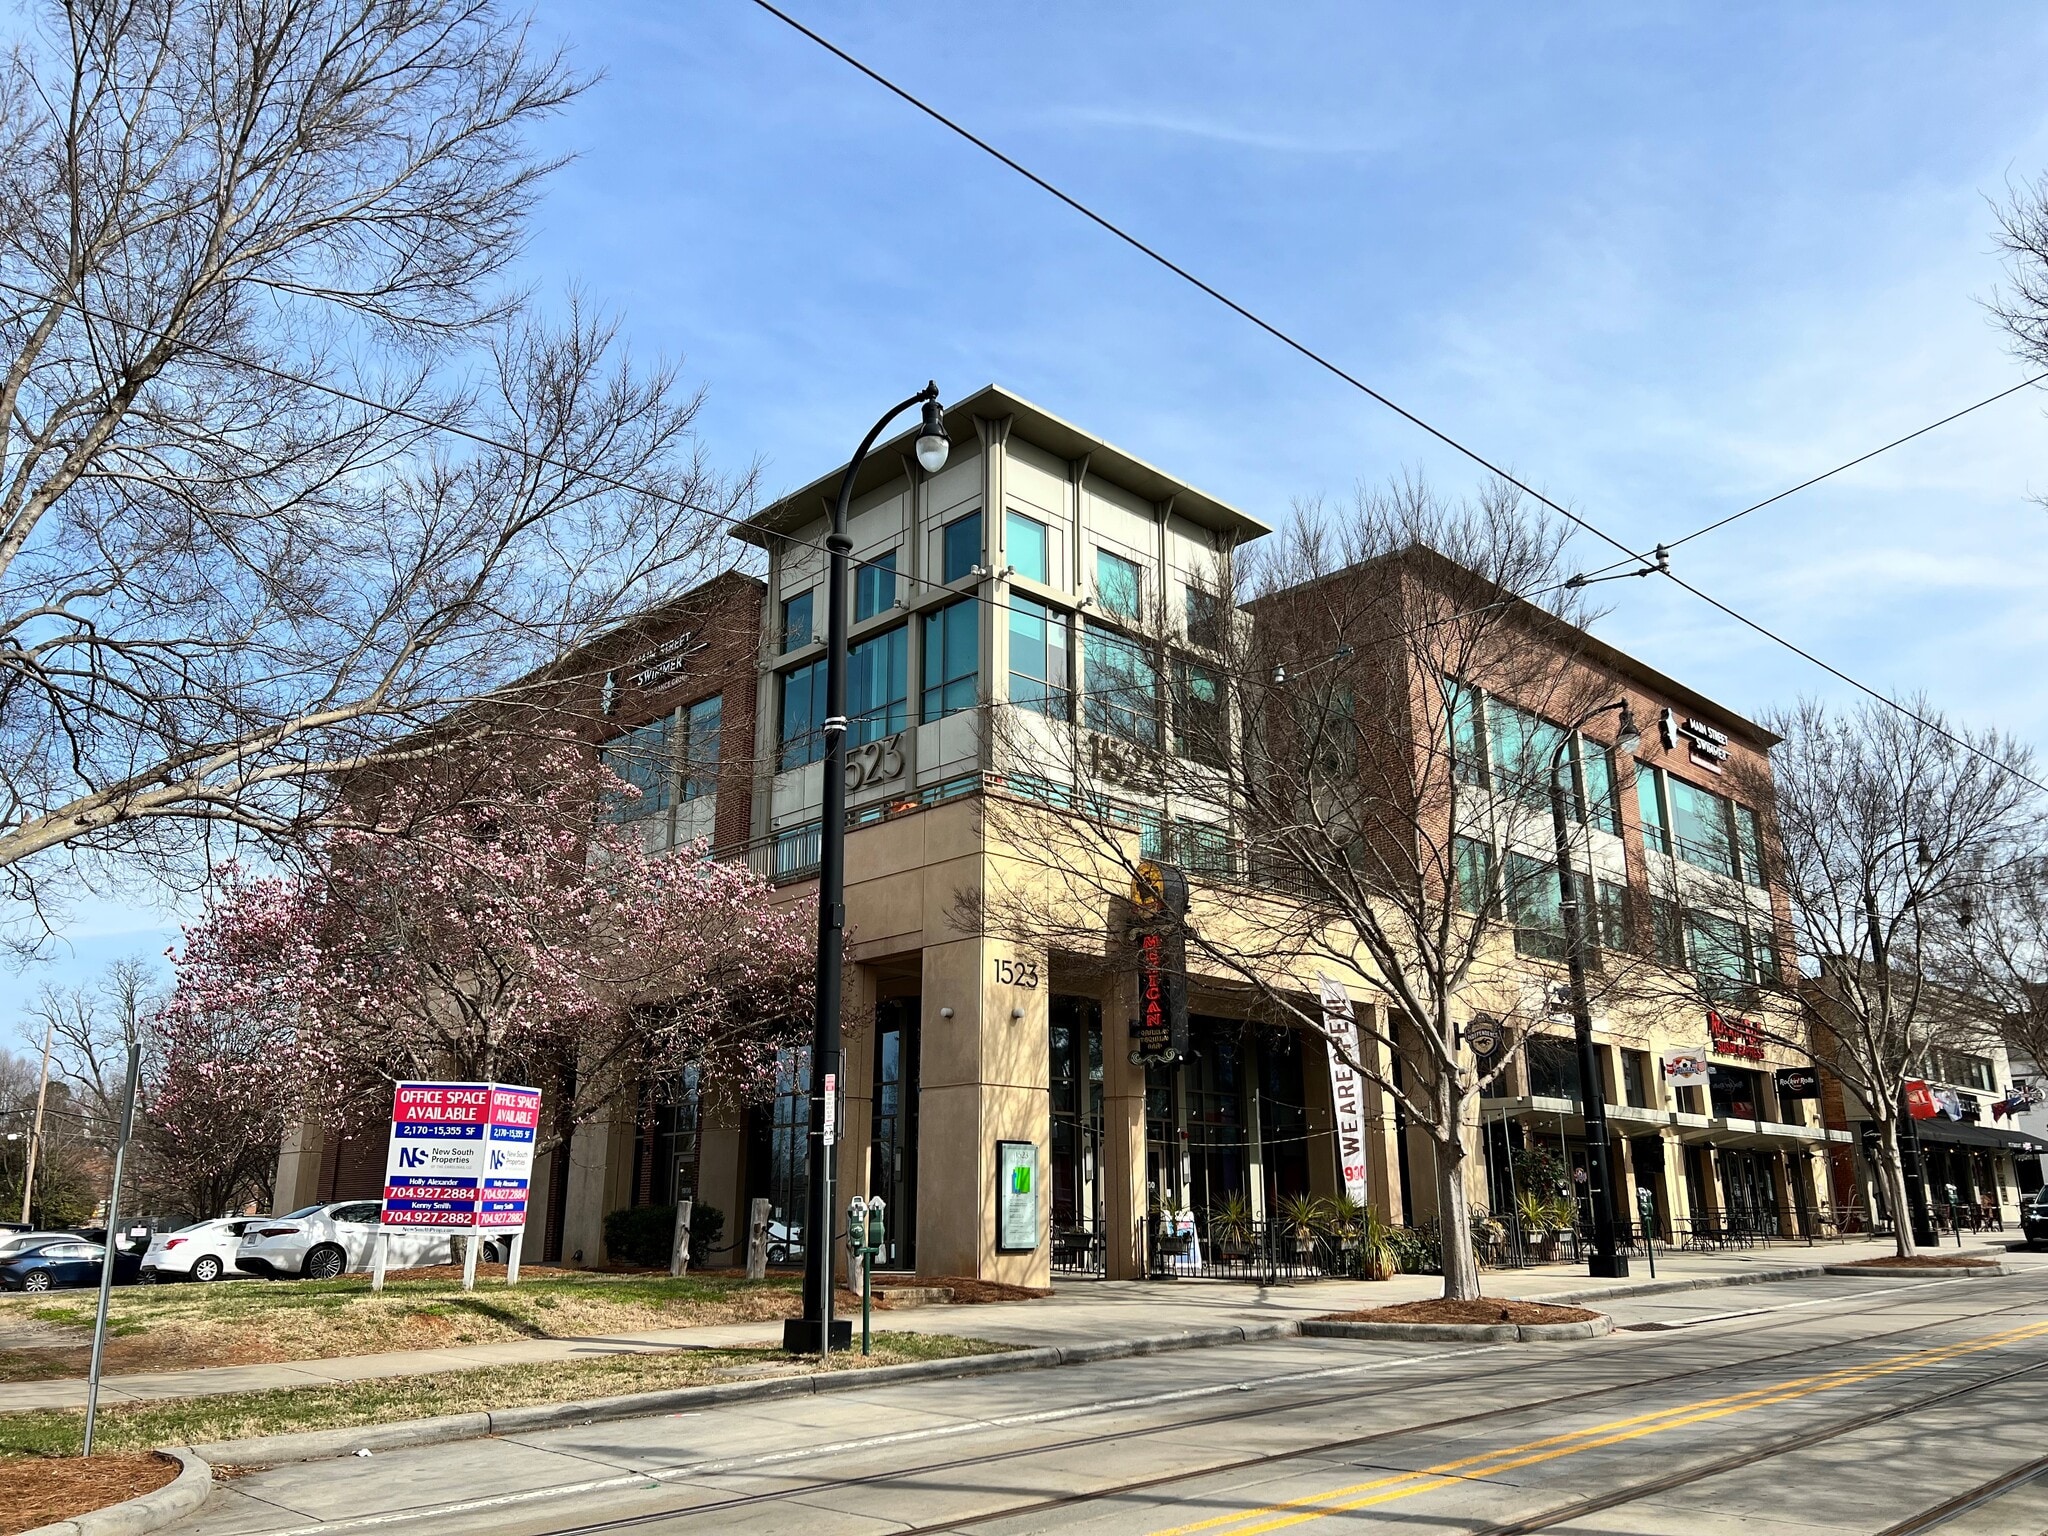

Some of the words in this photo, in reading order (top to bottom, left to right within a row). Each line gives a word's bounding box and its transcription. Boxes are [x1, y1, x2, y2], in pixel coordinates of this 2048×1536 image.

[845, 733, 904, 791] 523
[994, 958, 1039, 989] 1523
[1142, 935, 1162, 1027] MEICAN
[400, 1090, 443, 1104] OFFICE
[446, 1092, 487, 1105] SPACE
[1335, 1069, 1357, 1115] ARE
[493, 1092, 517, 1108] OFFICE
[517, 1096, 538, 1110] SPACE
[406, 1107, 478, 1121] AVAILABLE
[496, 1108, 533, 1125] AVAILABLE
[403, 1126, 462, 1136] 2,170-15,355
[465, 1127, 476, 1136] SF
[1340, 1119, 1361, 1158] WE
[399, 1147, 430, 1168] NS
[432, 1147, 451, 1155] New
[451, 1148, 474, 1156] South
[431, 1156, 470, 1165] Properties
[409, 1178, 425, 1186] Holly
[427, 1178, 459, 1186] Alexander
[389, 1187, 475, 1200] 704.927.2884
[483, 1189, 527, 1201] 704.927.2884
[412, 1202, 431, 1210] Kenny
[433, 1202, 451, 1210] Smith
[387, 1211, 473, 1224] 704.927.2882
[480, 1212, 524, 1224] 704.927.2882
